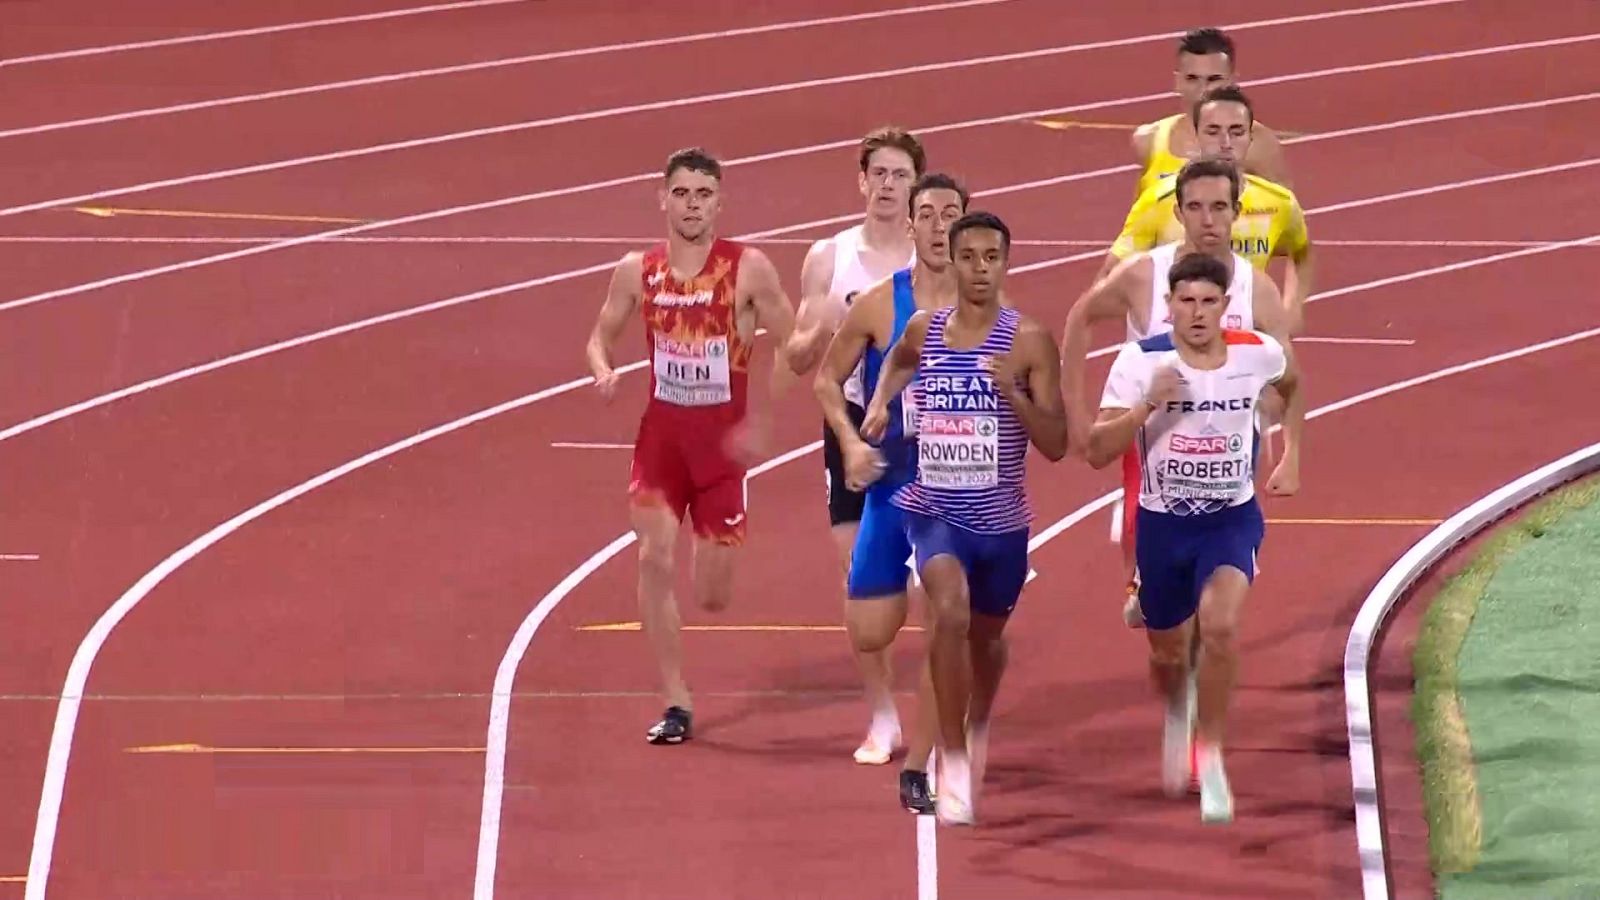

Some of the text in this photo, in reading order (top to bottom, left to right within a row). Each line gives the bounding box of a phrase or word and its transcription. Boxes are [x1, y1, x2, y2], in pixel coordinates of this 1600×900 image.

[1230, 238, 1269, 254] DEN
[667, 361, 710, 381] BEN
[925, 377, 993, 392] GREAT
[925, 394, 998, 410] BRITAIN
[1166, 397, 1252, 413] FRANCE
[921, 418, 974, 434] SPAR
[921, 442, 995, 462] ROWDEN
[1170, 436, 1226, 453] SPAR
[1168, 459, 1243, 479] ROBERT
